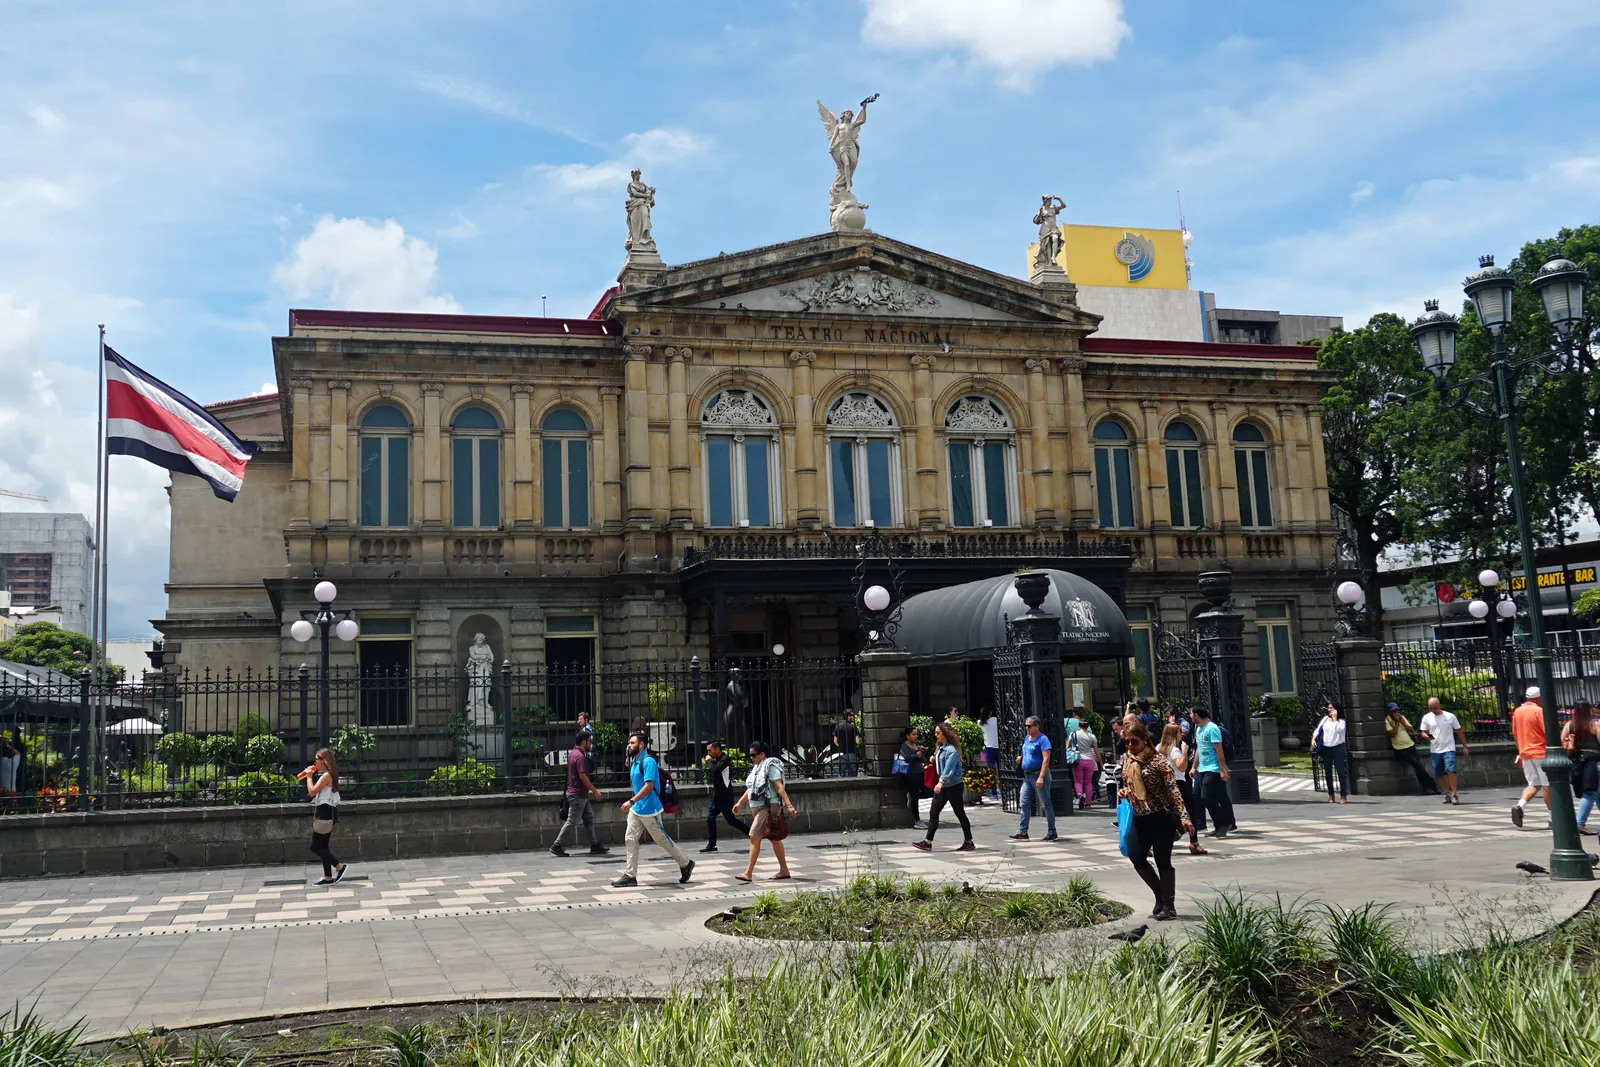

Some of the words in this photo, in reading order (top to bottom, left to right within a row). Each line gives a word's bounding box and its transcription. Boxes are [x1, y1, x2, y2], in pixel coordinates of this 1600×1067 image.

[771, 325, 843, 342] TEATRO
[864, 329, 954, 344] NACIONAL
[1575, 568, 1595, 582] BAR
